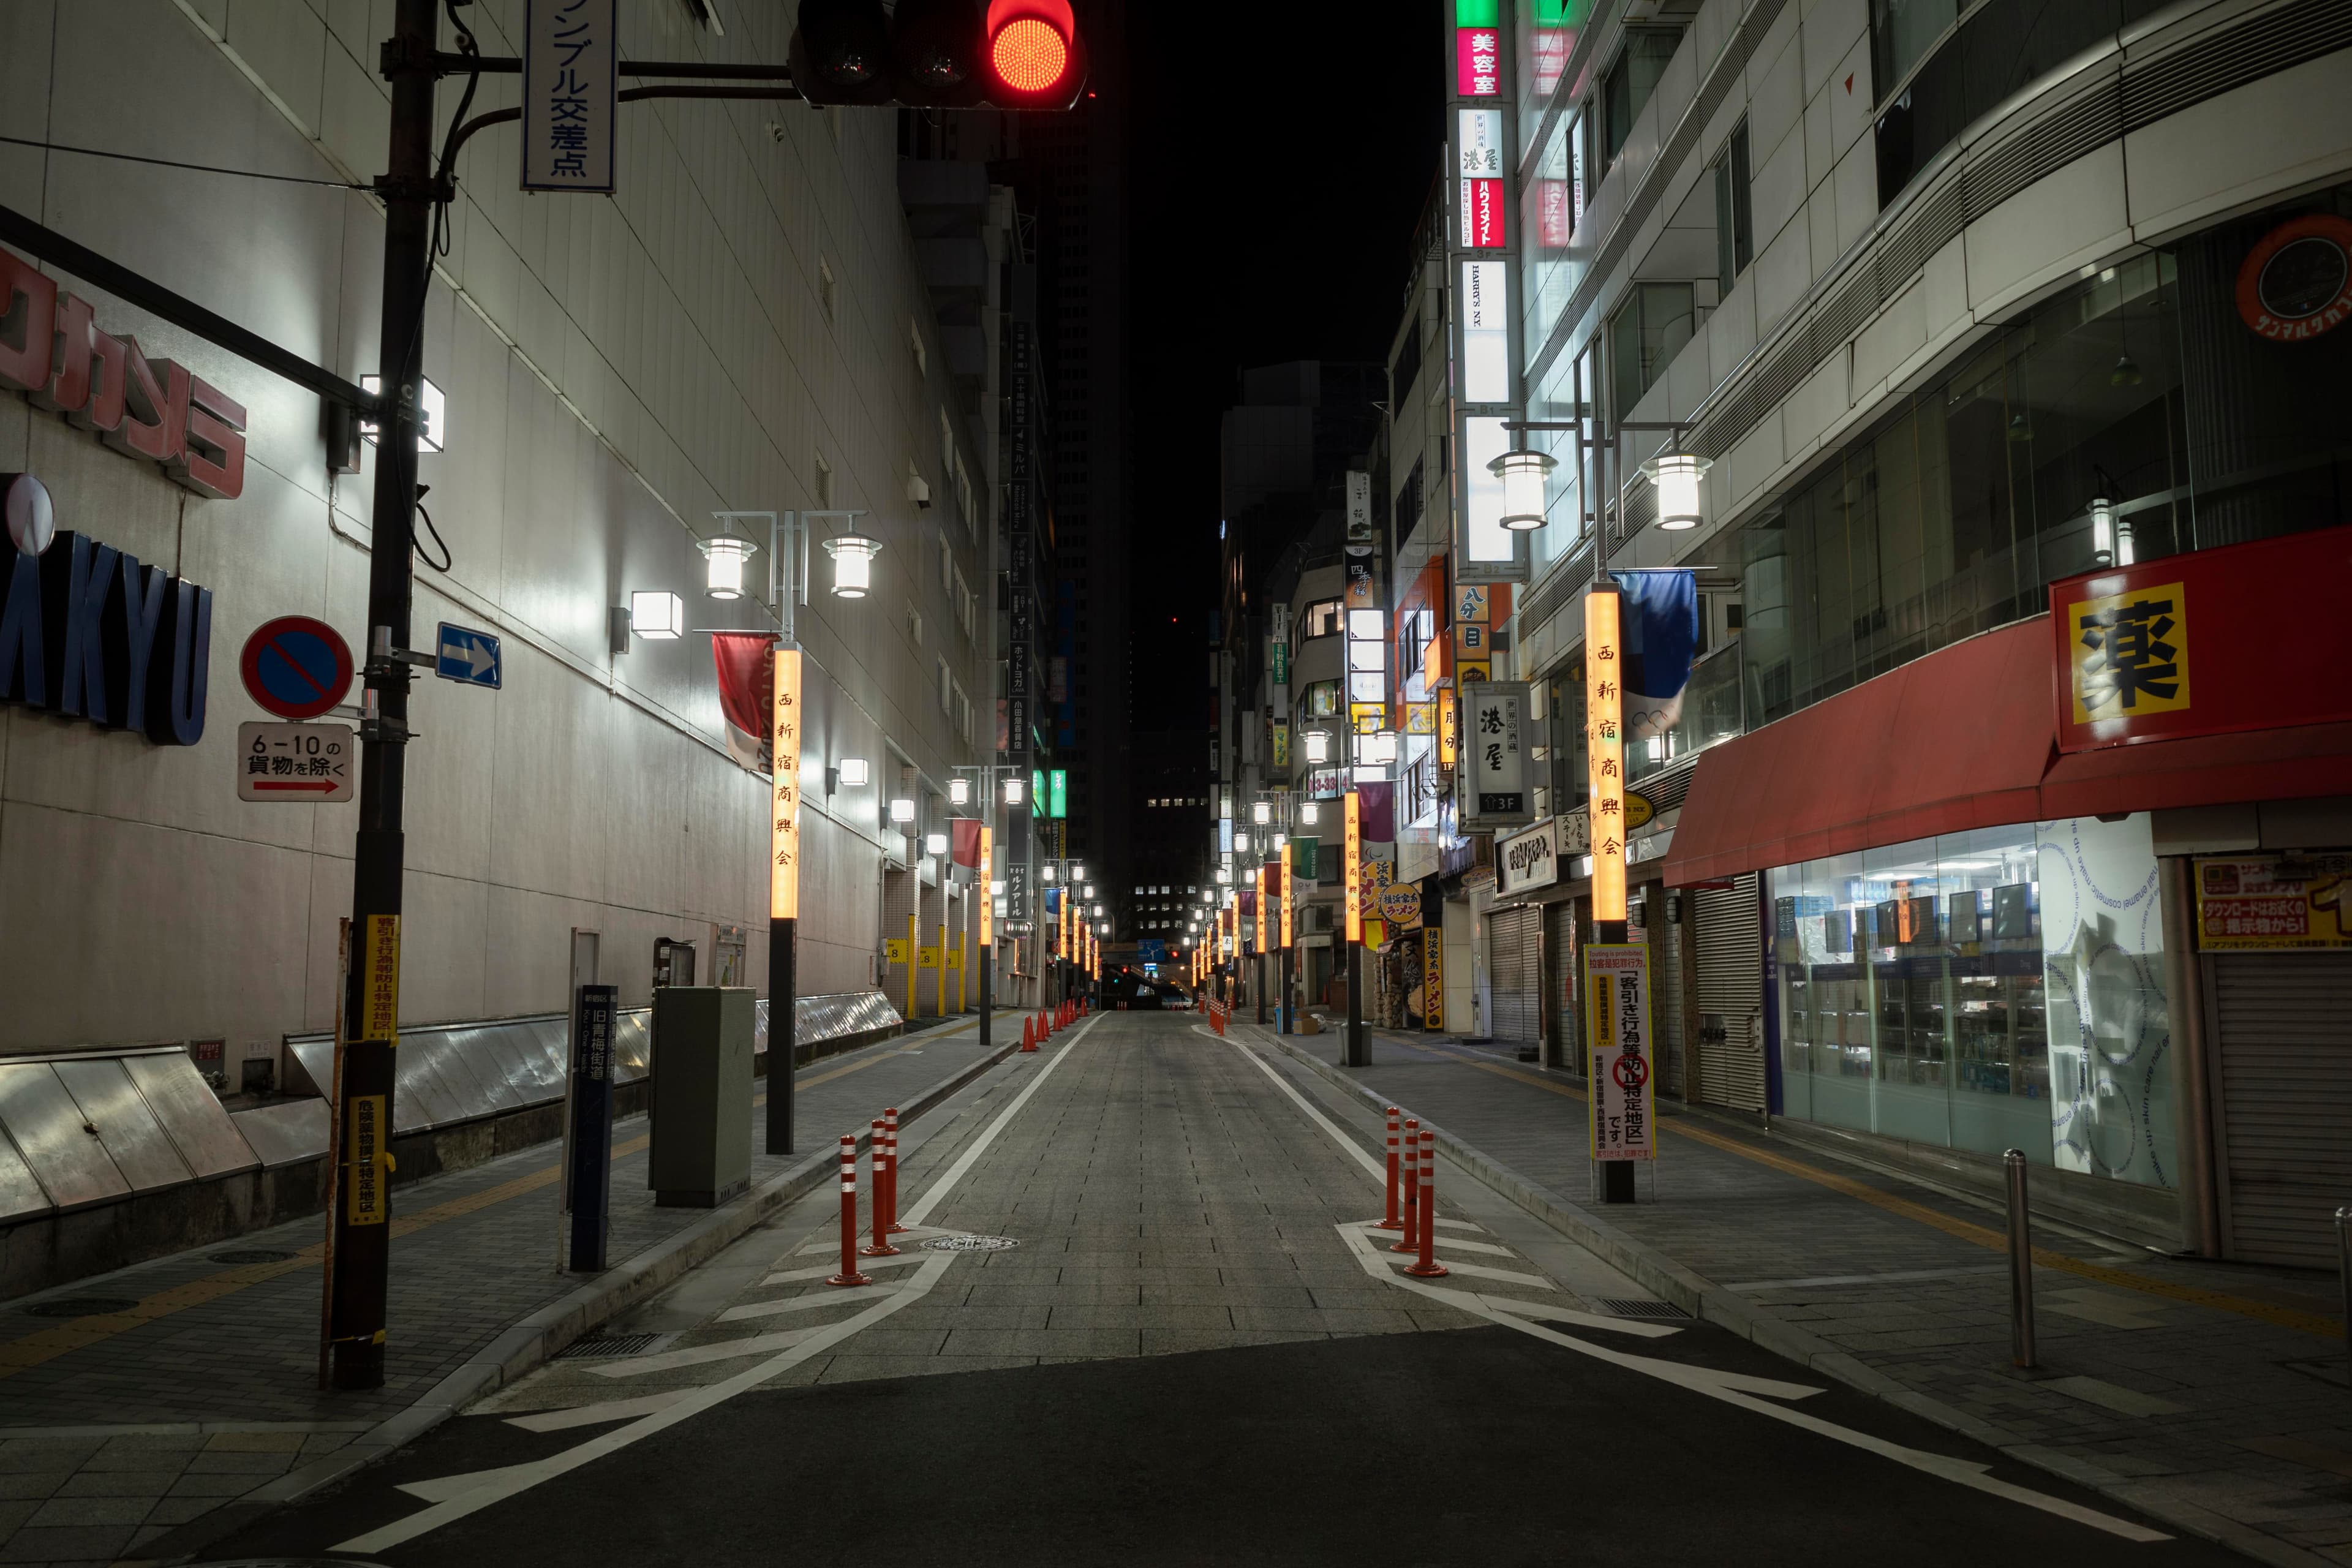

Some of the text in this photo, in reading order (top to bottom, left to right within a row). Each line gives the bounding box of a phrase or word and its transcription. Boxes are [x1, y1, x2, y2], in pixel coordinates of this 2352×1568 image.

[1472, 34, 1496, 94] 美容室
[1464, 148, 1498, 170] 港屋
[1479, 181, 1491, 245] ハウスメイト
[1460, 587, 1487, 648] 八分目
[1014, 646, 1023, 687] ホットヨガ
[2079, 600, 2180, 711] 薬
[1014, 701, 1022, 749] 小田急百貨店
[1480, 706, 1506, 771] 港屋
[1507, 701, 1518, 752] 世界の酒蔵
[248, 755, 345, 777] 貨物を除く
[1597, 644, 1621, 856] 西新宿商興会
[775, 693, 794, 865] 西新宿商興会
[1499, 798, 1515, 809] 3F
[1575, 815, 1584, 848] いきなり
[2073, 837, 2081, 853] up
[1348, 816, 1359, 911] 西新宿商興会
[2078, 856, 2092, 886] make
[1012, 876, 1022, 916] ルノアール
[1384, 892, 1418, 905] 横浜家系
[1387, 904, 1417, 916] ラーメン
[2090, 884, 2122, 909] cosmetic
[2122, 884, 2149, 911] enamel
[2205, 900, 2305, 918] ダウンロードはお近くの
[2226, 918, 2305, 934] 掲示物から!
[891, 949, 899, 958] 8
[584, 994, 607, 1003] 新宿区
[591, 1009, 606, 1079] 旧青梅街道
[1620, 971, 1644, 1144] 「客引き行為等防止特定地区」
[1608, 1116, 1621, 1148] です。
